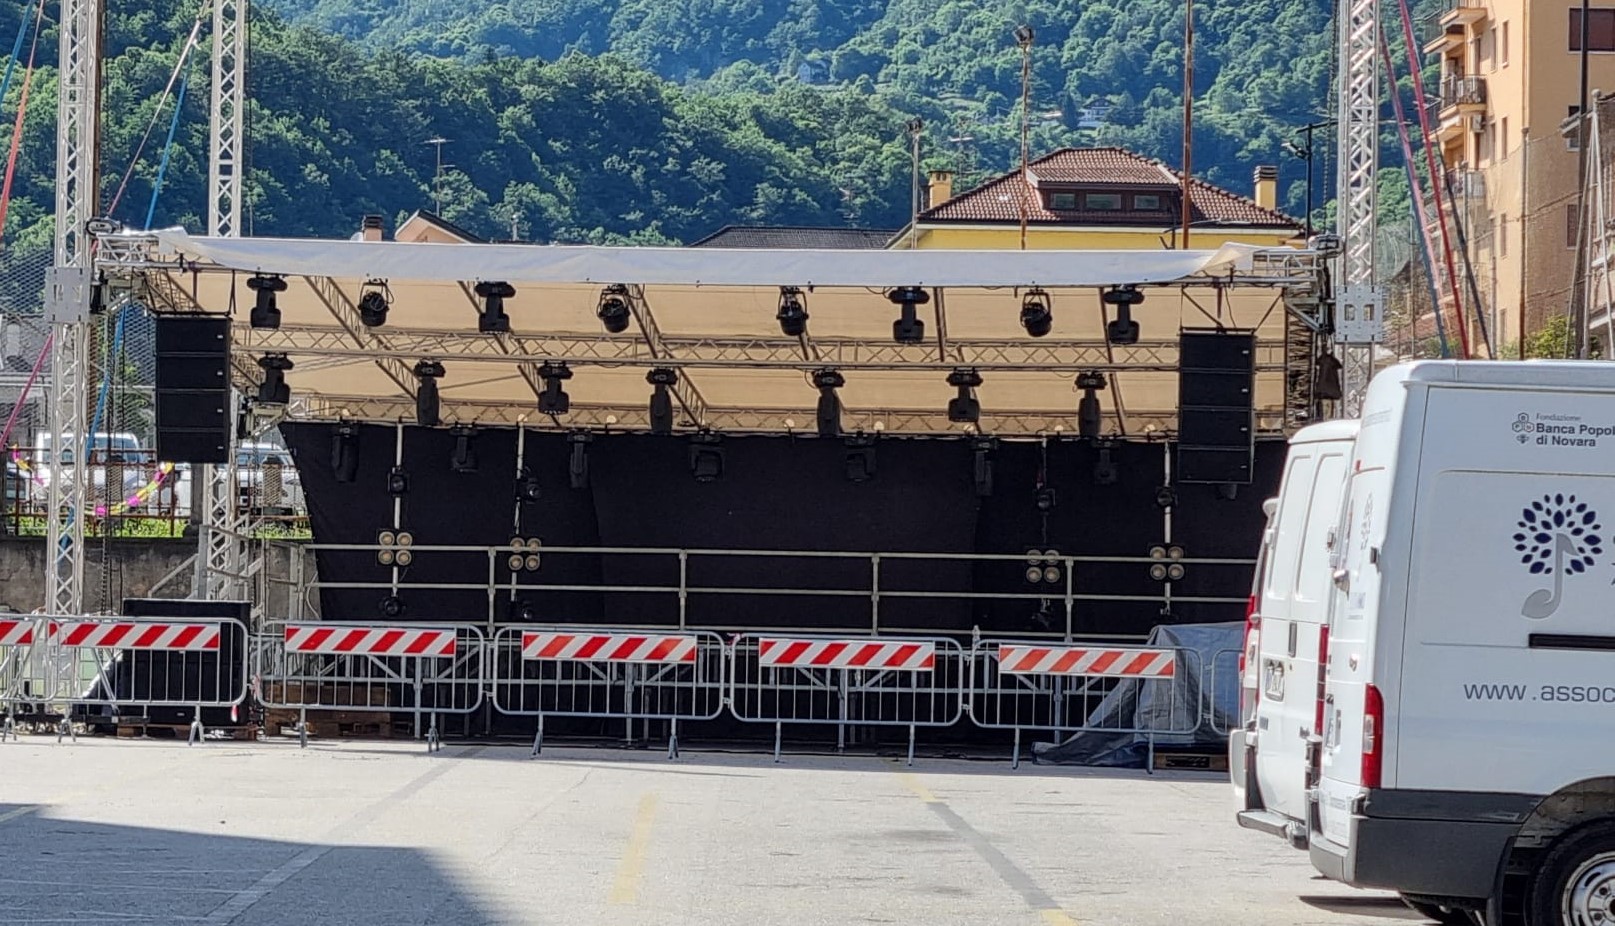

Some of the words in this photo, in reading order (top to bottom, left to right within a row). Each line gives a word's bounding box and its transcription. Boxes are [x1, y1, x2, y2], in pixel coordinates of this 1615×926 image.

[1536, 423, 1575, 434] Banca
[1536, 435, 1548, 445] di
[1551, 436, 1596, 447] Novara
